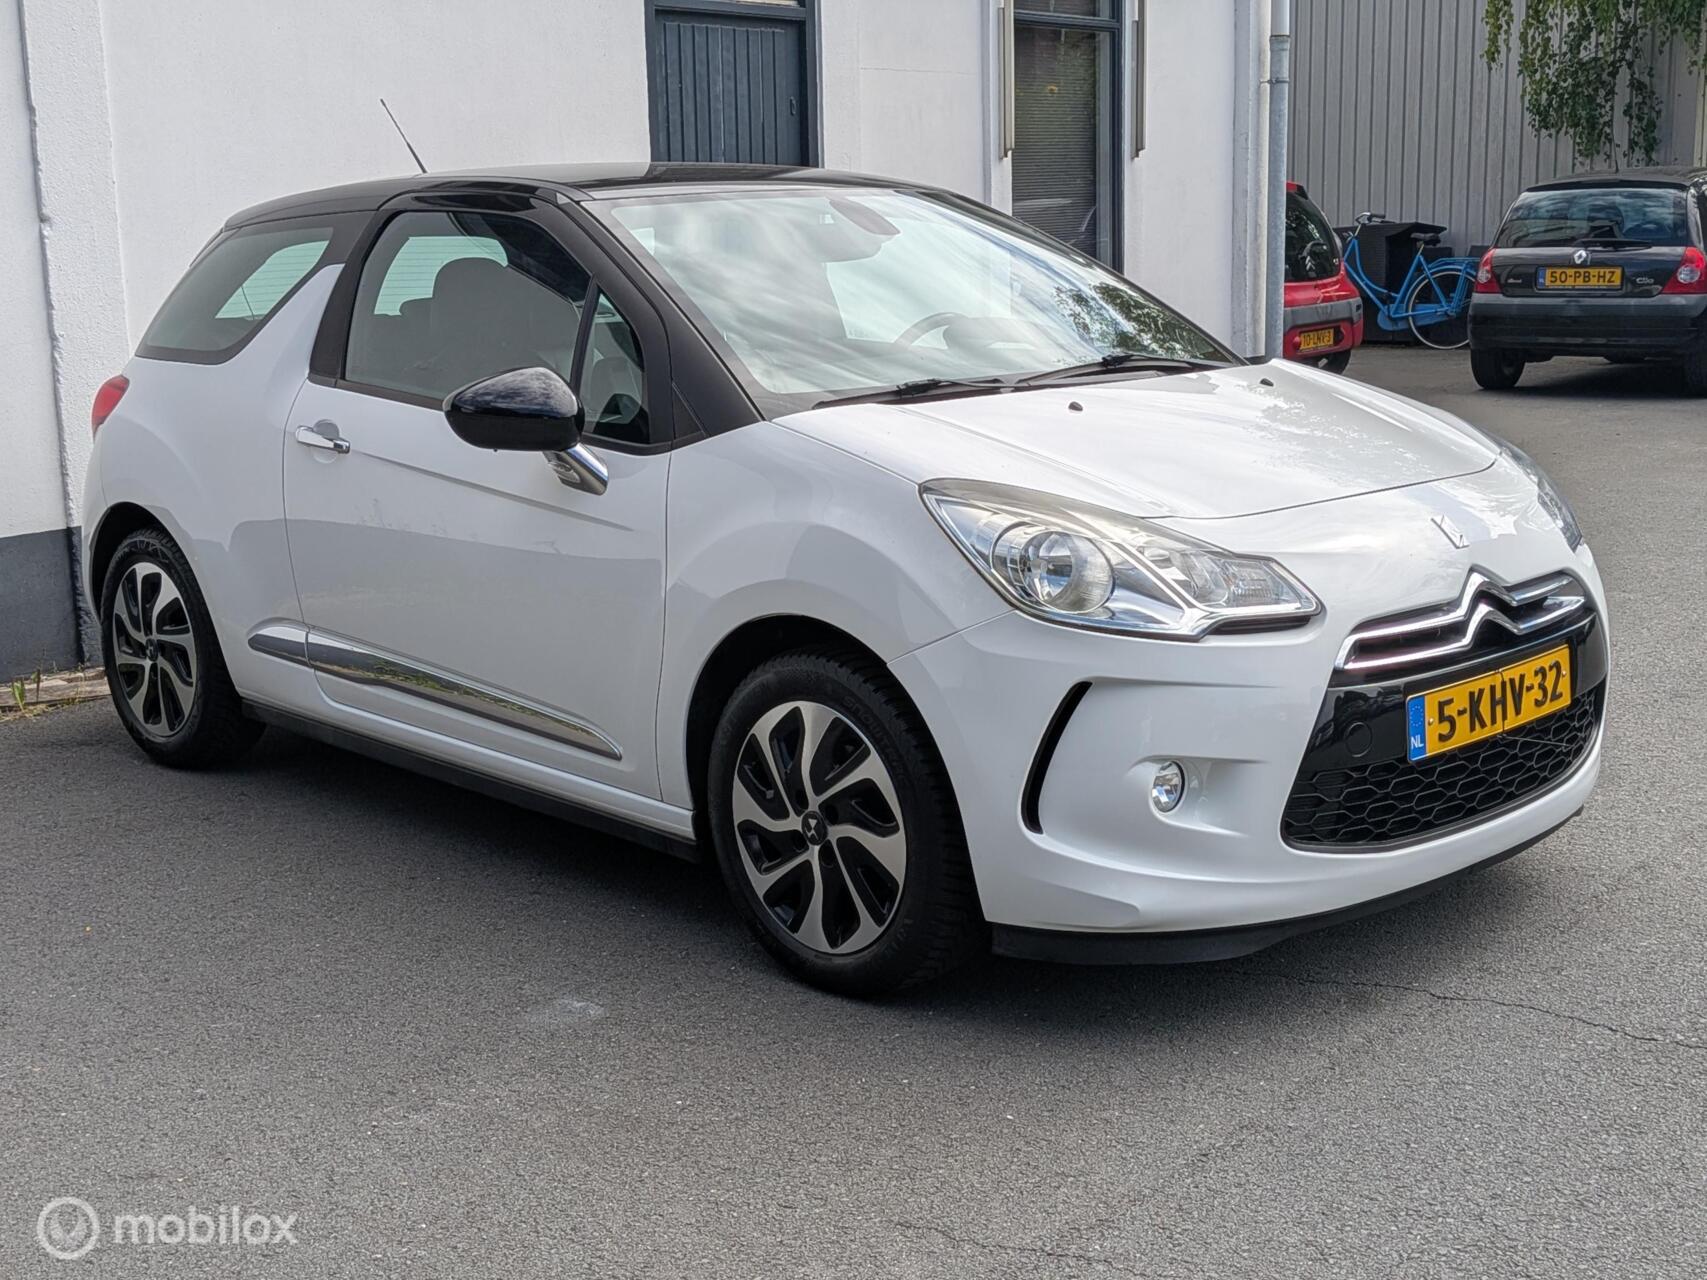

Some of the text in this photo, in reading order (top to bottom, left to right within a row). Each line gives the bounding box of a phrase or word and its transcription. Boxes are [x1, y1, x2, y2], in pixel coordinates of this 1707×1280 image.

[1550, 271, 1616, 284] 50-PB-HZ
[1437, 660, 1563, 743] 5-KHV-32
[1410, 734, 1424, 750] NL
